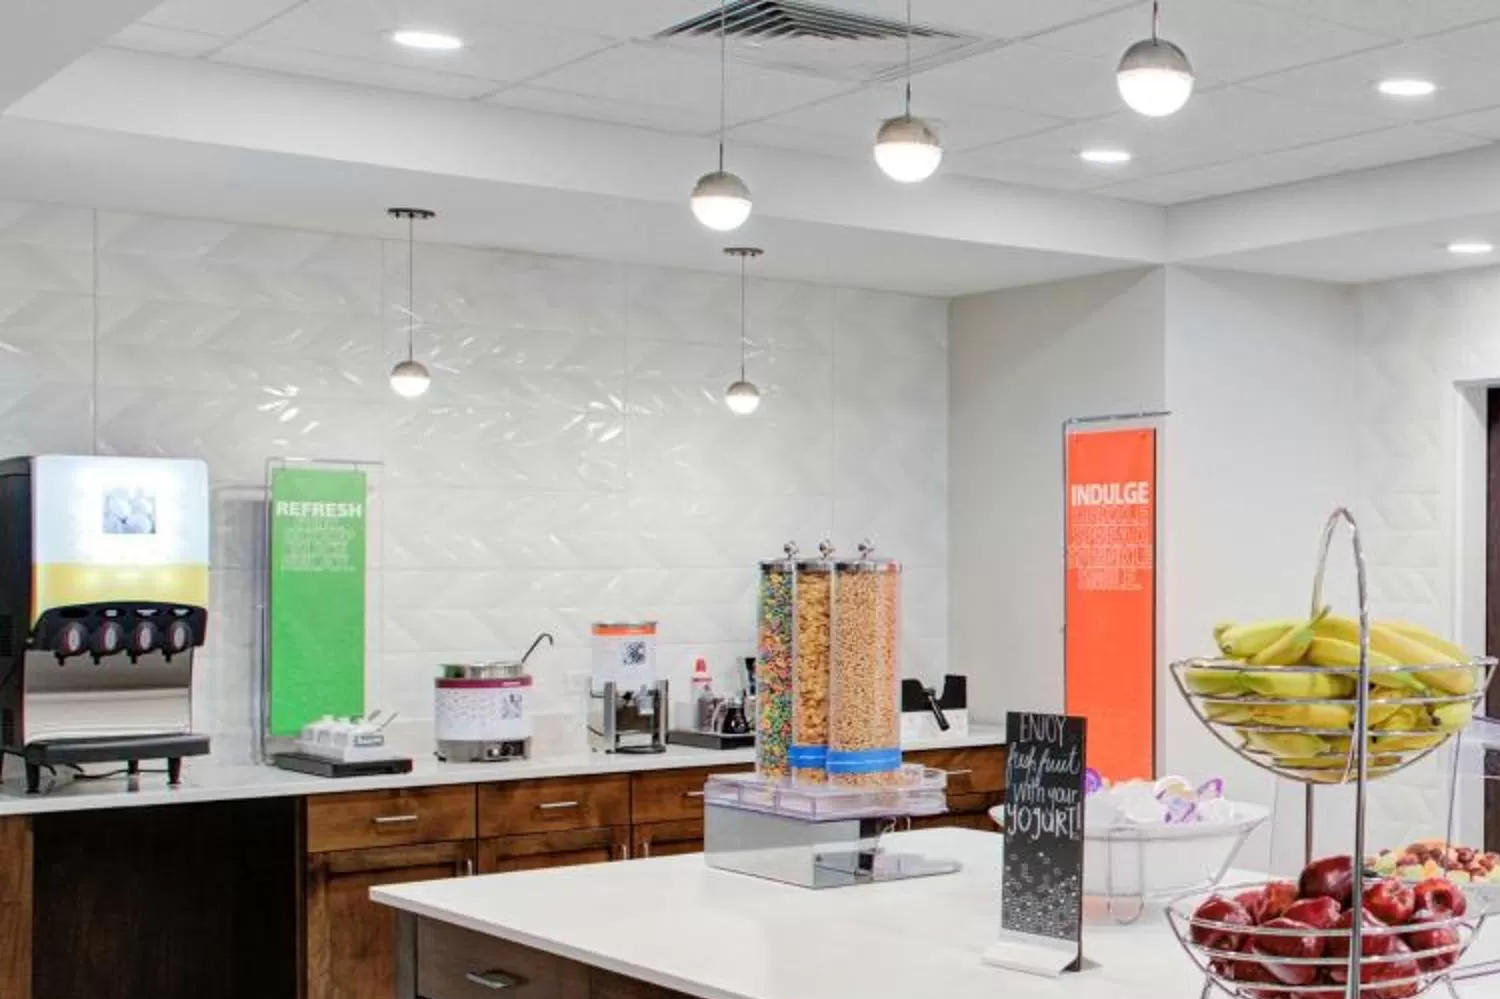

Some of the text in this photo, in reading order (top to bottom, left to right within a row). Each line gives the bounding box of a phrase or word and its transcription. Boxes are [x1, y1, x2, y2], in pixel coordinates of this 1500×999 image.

[1071, 481, 1149, 506] INDULGE
[276, 501, 362, 518] REFRESH
[1020, 712, 1066, 748] ENJOY
[1012, 780, 1079, 816] with your
